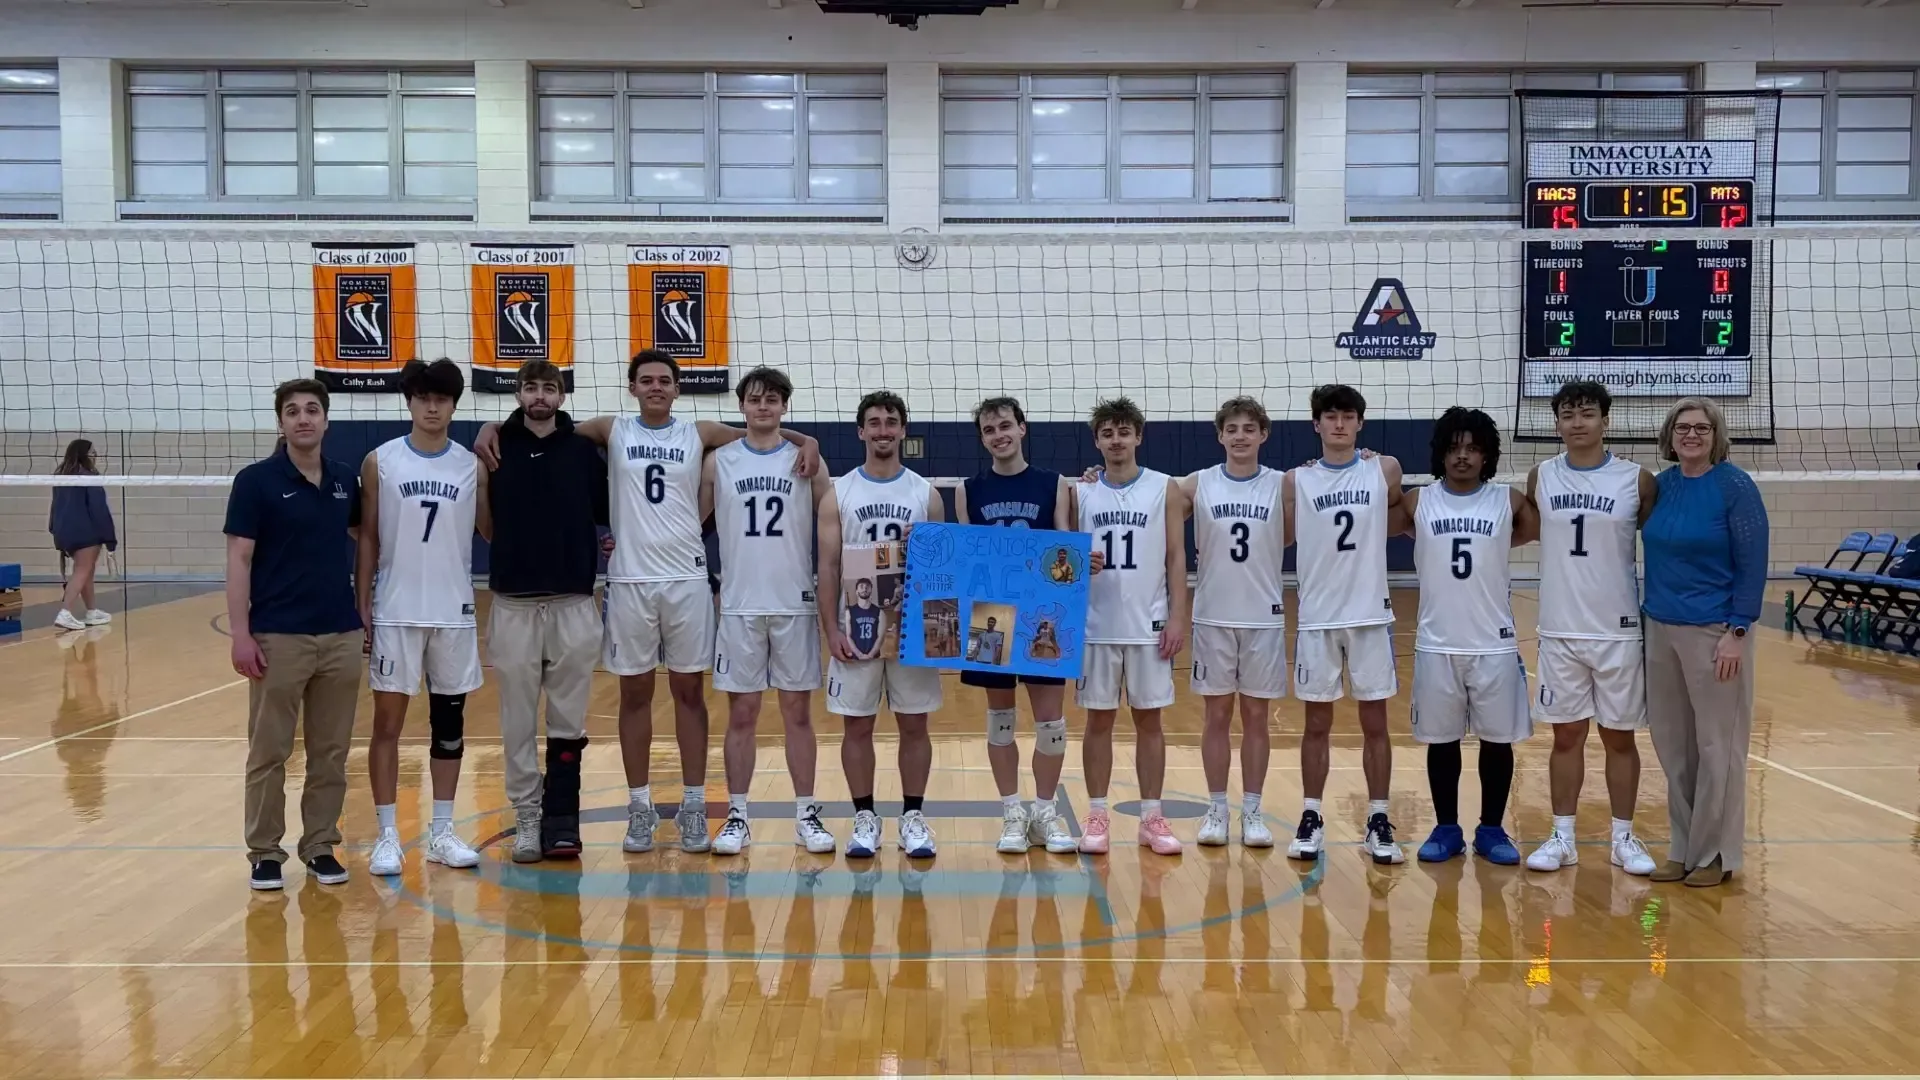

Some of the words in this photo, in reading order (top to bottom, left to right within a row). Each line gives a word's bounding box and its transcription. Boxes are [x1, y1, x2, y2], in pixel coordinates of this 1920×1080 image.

[1569, 146, 1713, 160] IMMACULATA
[1569, 162, 1713, 176] UNIVERSITY
[1537, 187, 1577, 201] MACS
[1711, 187, 1740, 200] PATS
[1550, 240, 1583, 250] BONUS
[1696, 240, 1729, 250] BONUS
[319, 251, 353, 264] Class
[357, 251, 370, 264] of
[374, 251, 407, 263] 2000
[478, 250, 512, 263] Class
[516, 250, 530, 263] of
[533, 251, 565, 263] 2001
[635, 249, 668, 261] Class
[672, 249, 685, 262] of
[689, 250, 721, 261] 2002
[1698, 257, 1747, 268] TIMEOUTS
[1534, 258, 1583, 269] TIMEOUTS
[1559, 271, 1565, 292] 1
[1714, 269, 1729, 292] 0
[1545, 295, 1569, 305] LEFT
[1710, 294, 1733, 304] LEFT
[1544, 311, 1574, 321] FOULS
[1605, 310, 1642, 320] PLAYER
[1649, 310, 1680, 320] FOULS
[1702, 310, 1733, 320] FOULS
[1340, 336, 1400, 346] ATLANTIC
[1403, 336, 1434, 346] EAST
[1560, 322, 1575, 345] 2
[1717, 322, 1732, 345] 2
[1353, 347, 1421, 357] CONFERENCE
[1549, 347, 1570, 356] WON
[1706, 346, 1726, 355] WON
[342, 378, 365, 388] Cathy
[367, 378, 386, 386] Rush
[495, 376, 517, 385] There
[700, 376, 725, 385] Stanley
[1544, 371, 1732, 387] www.gomightymacs.com
[626, 445, 685, 464] IMMACULATA
[398, 480, 460, 502] IMMACULATA
[644, 464, 666, 504] 6
[735, 476, 793, 496] IMMACULATA
[1312, 490, 1371, 512] IMMACULATA
[1549, 494, 1615, 515] IMMACULATA
[744, 495, 784, 537] 12
[854, 504, 912, 523] IMMACULATA
[1092, 511, 1149, 529] IMMACULATA
[1210, 503, 1270, 522] IMMACULATA
[420, 500, 439, 543] 7
[1430, 518, 1494, 537] IMMACULATA
[1333, 510, 1356, 552] 2
[1569, 513, 1588, 557] 1
[965, 536, 1039, 558] SENIOR
[1101, 530, 1138, 570] 11
[1230, 522, 1250, 563] 3
[1450, 537, 1473, 580] 5
